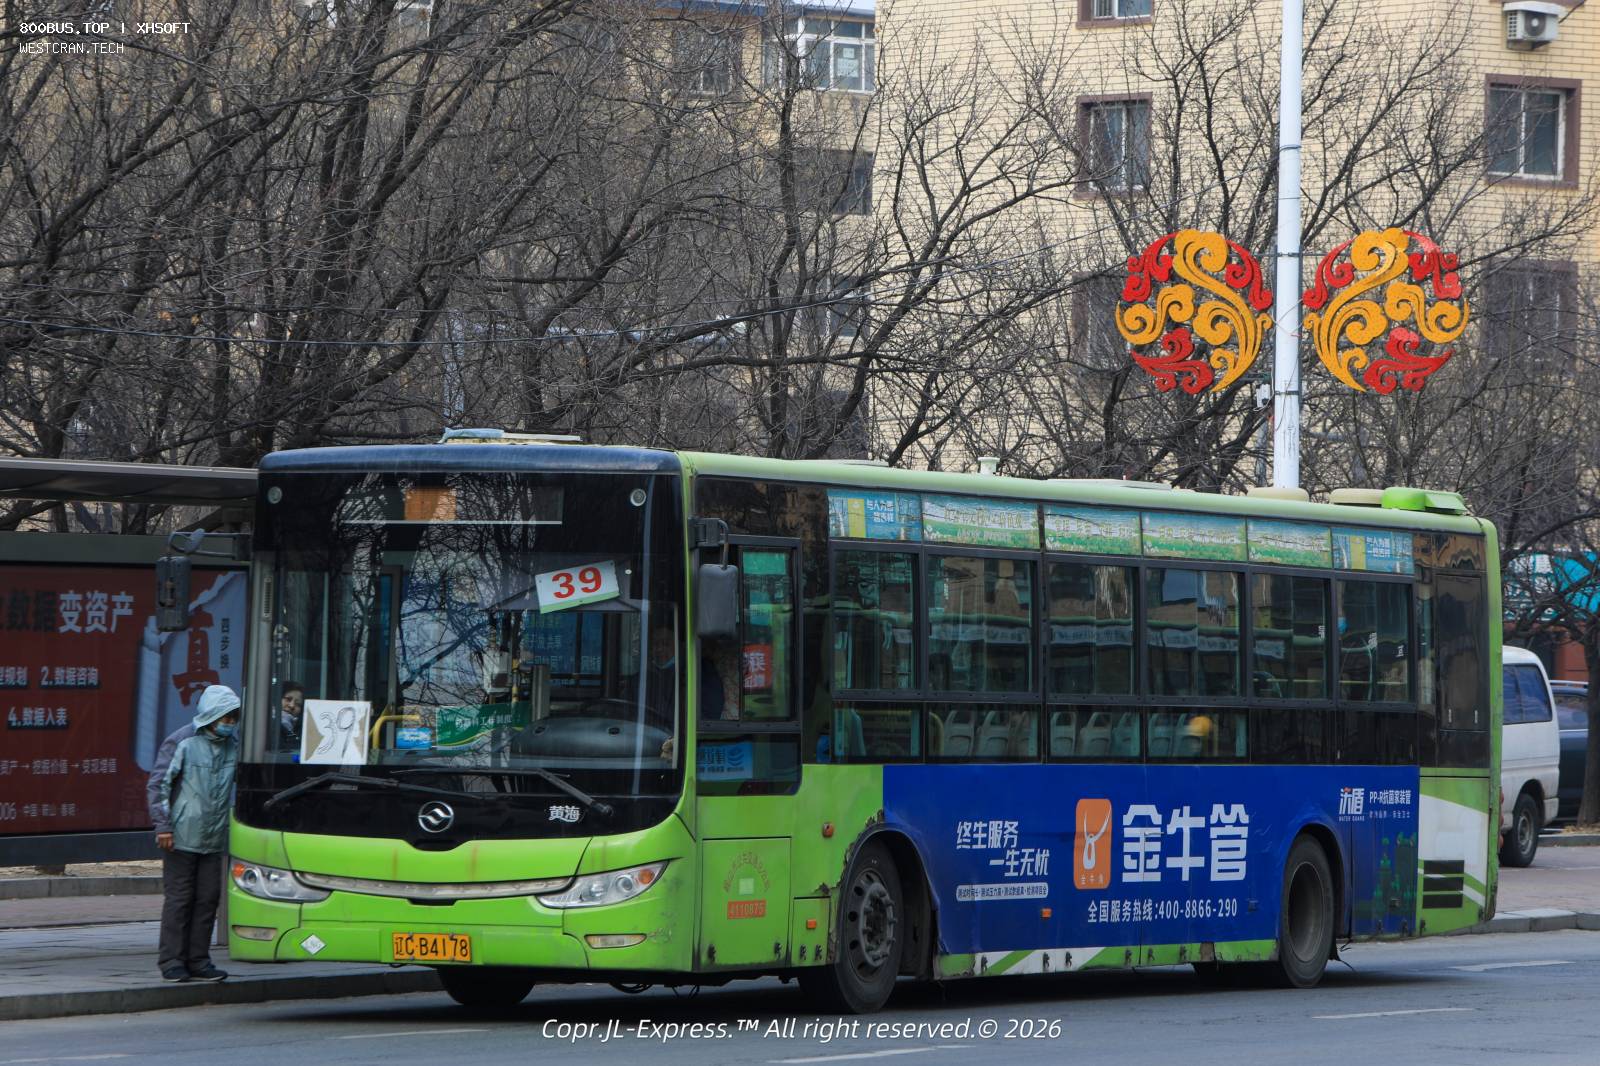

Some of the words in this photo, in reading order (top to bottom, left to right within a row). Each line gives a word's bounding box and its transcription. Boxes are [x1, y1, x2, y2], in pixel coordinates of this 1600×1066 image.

[551, 566, 603, 599] 39
[316, 706, 356, 759] 39
[956, 820, 1019, 850] 终生服务
[1122, 803, 1250, 883] 金牛管
[989, 848, 1050, 877] 一生无忧
